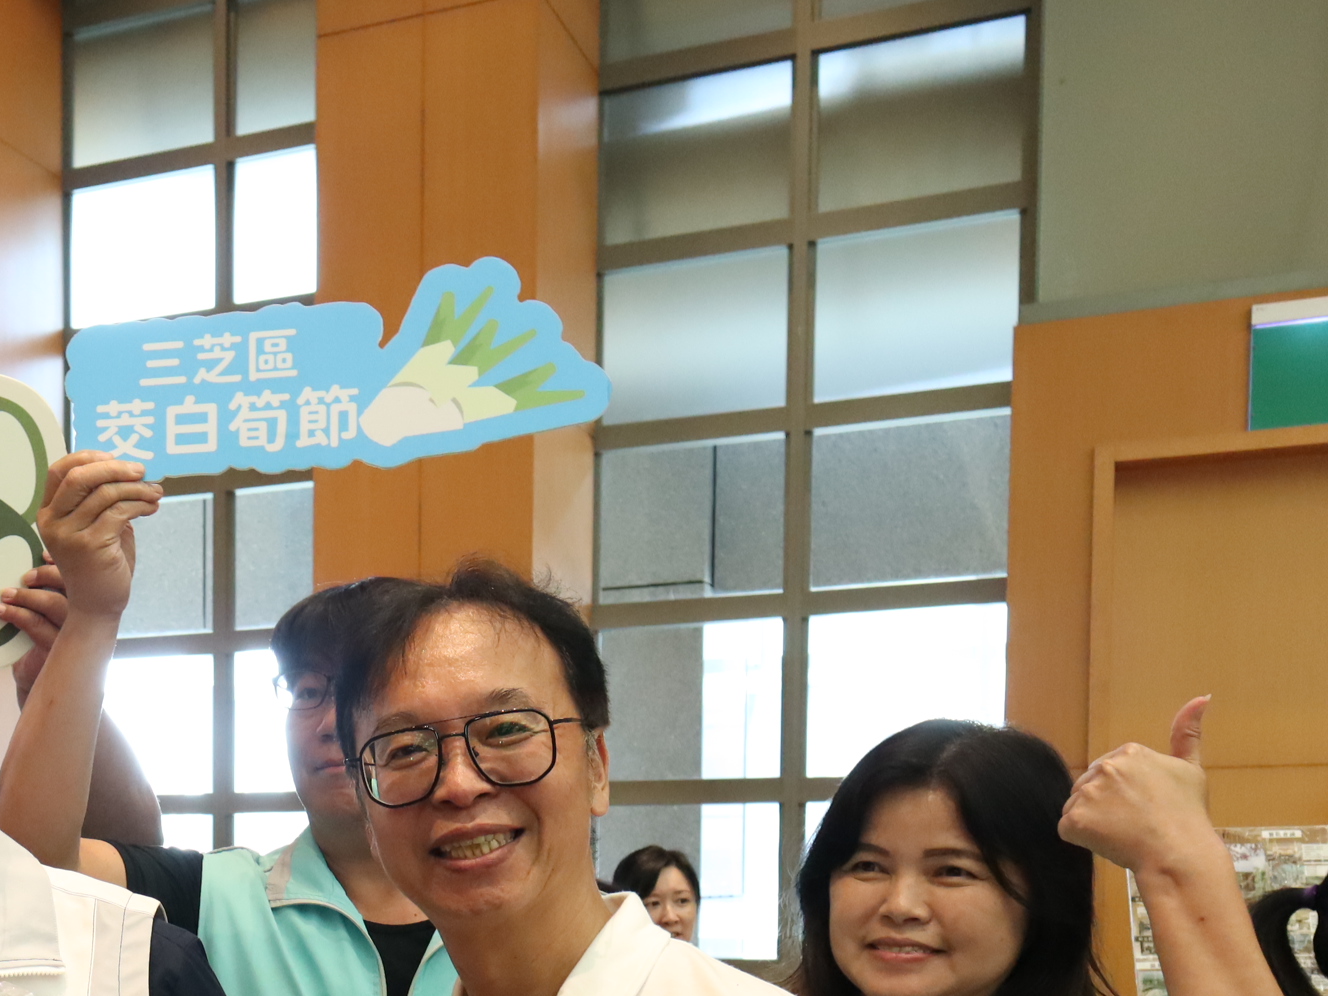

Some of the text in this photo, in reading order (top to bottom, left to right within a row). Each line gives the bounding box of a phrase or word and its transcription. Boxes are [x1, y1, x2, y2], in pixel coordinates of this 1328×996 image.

[139, 328, 298, 386] 三芝區
[96, 384, 359, 461] 茭白筍節
